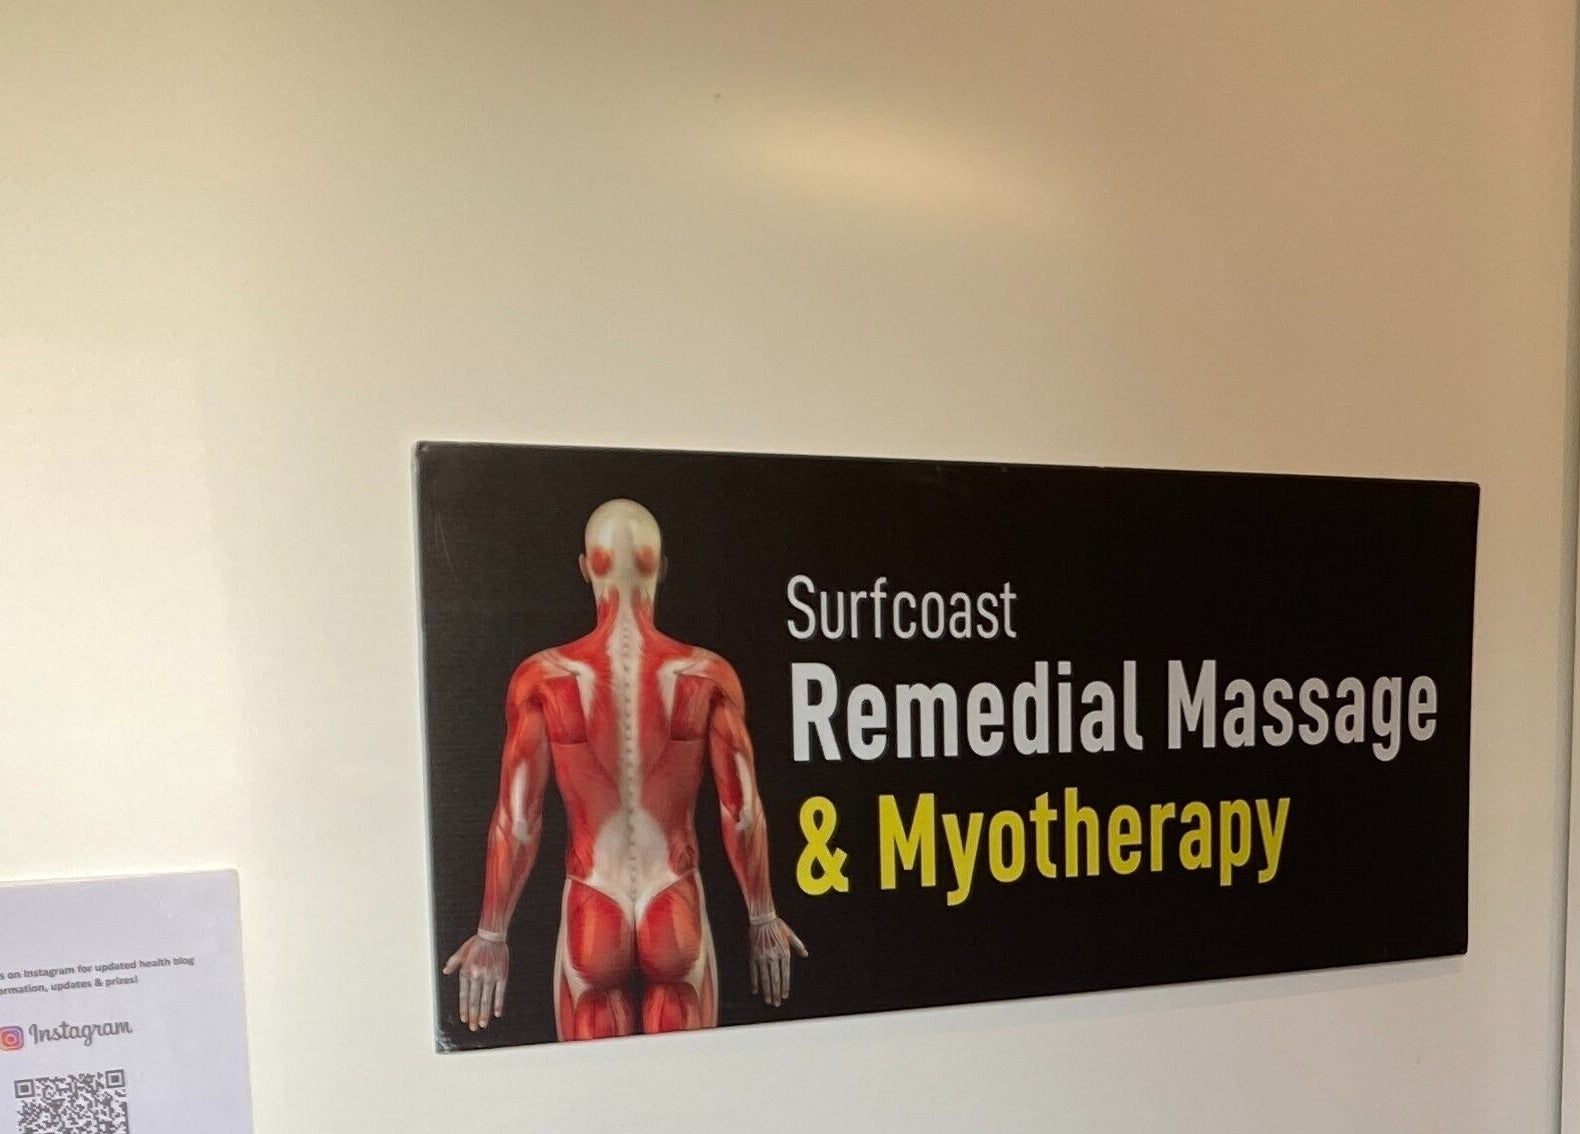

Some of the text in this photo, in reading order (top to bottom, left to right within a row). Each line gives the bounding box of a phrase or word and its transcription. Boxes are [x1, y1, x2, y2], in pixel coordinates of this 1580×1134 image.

[787, 574, 1017, 639] Surfcoast
[791, 659, 1438, 762] Remedial Massage
[796, 787, 1291, 906] & Myotherapy
[23, 967, 75, 978] Instagram
[77, 964, 93, 973] for
[95, 961, 137, 973] updated
[138, 959, 171, 968] health
[50, 981, 92, 991] updates
[94, 978, 103, 987] &
[28, 1020, 133, 1046] Instagram
